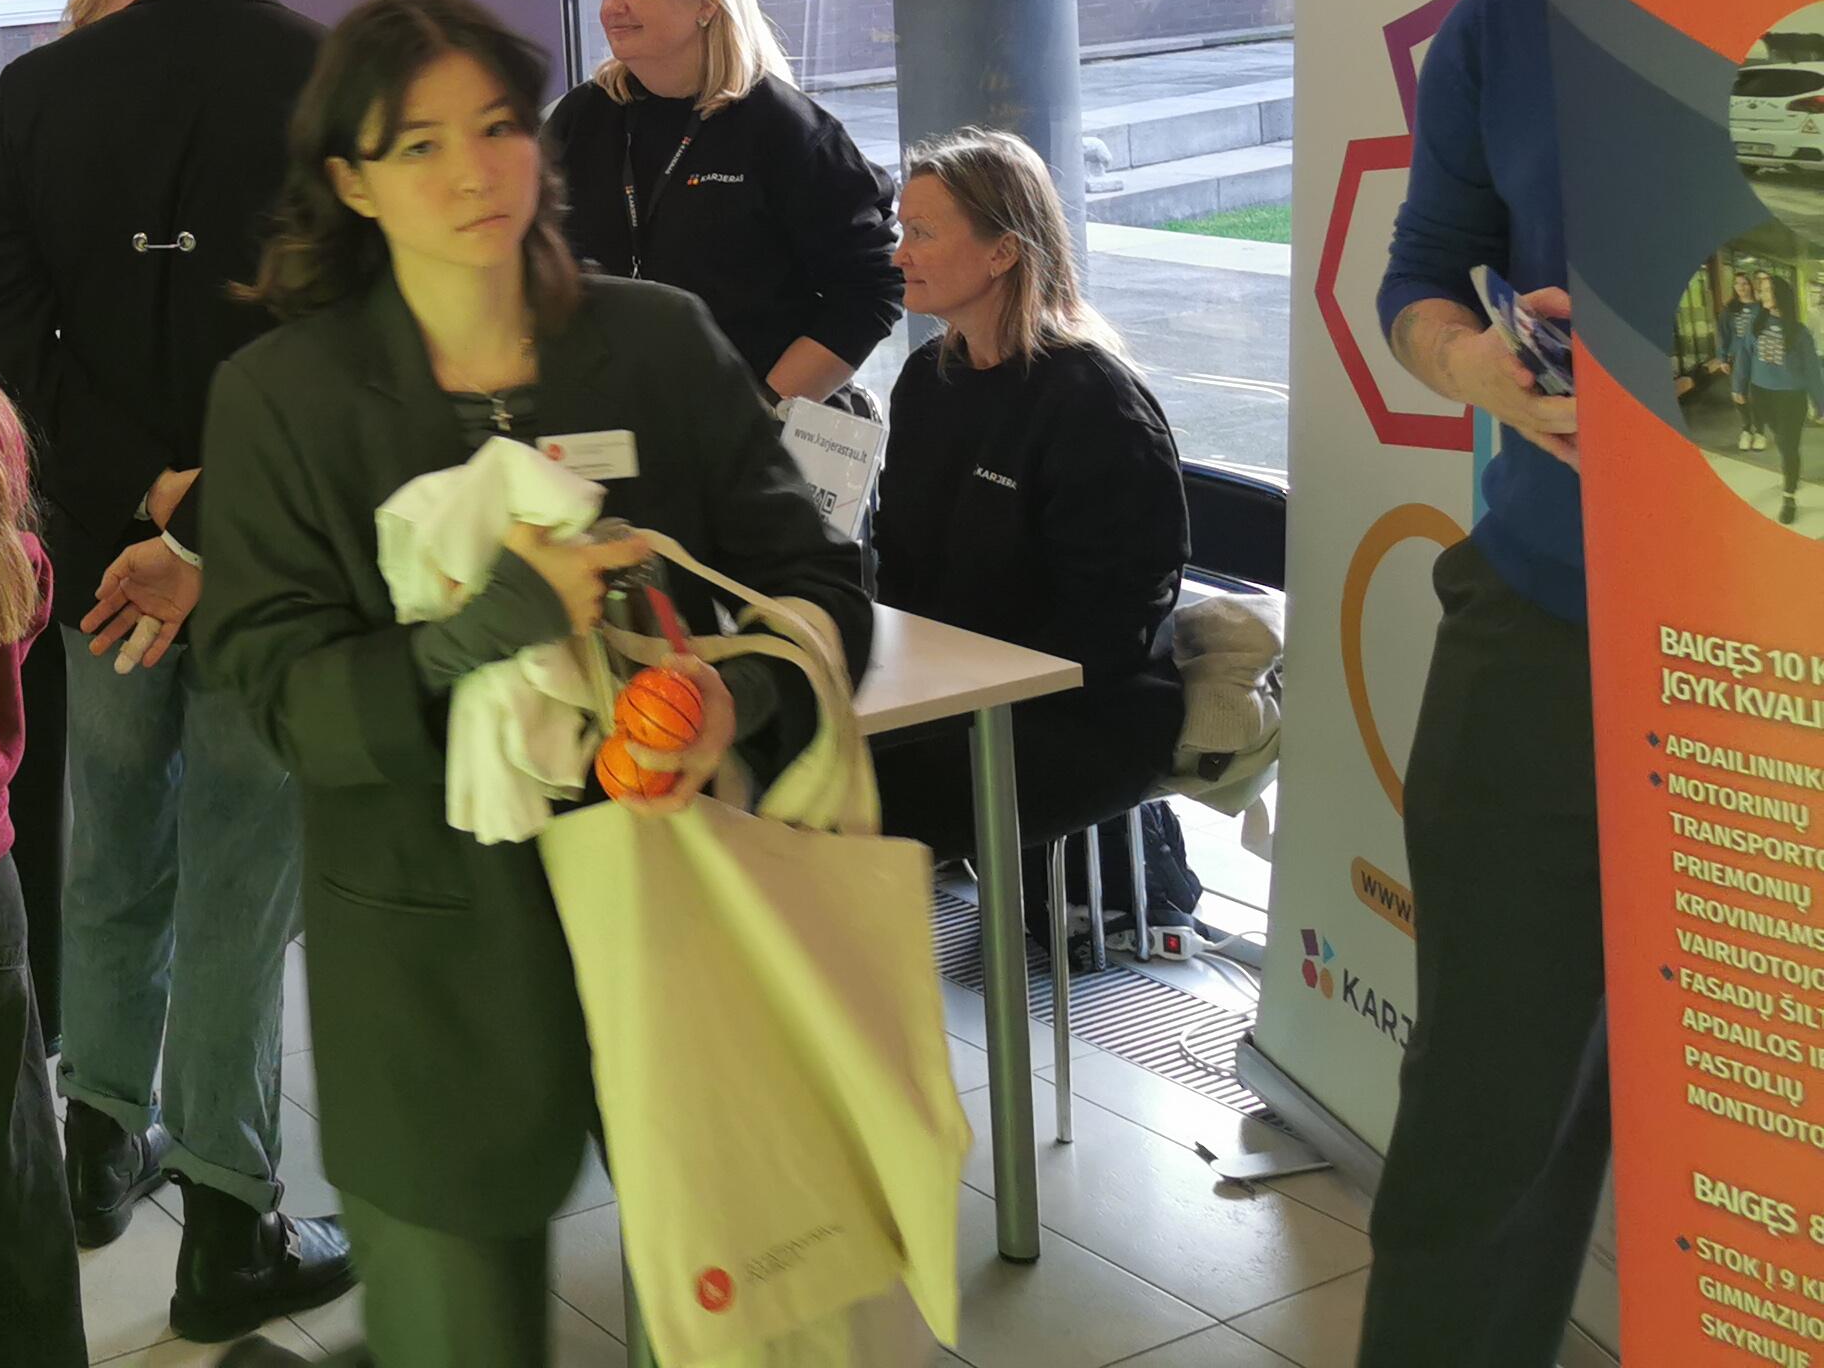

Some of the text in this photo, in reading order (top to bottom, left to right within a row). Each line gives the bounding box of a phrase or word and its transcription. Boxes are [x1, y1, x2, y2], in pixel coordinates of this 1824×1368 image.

[1660, 625, 1763, 679] BAIGĘS
[1766, 650, 1805, 682] 10
[1661, 667, 1731, 711] ĮGYK
[1665, 734, 1824, 791] APDAILININK
[1668, 772, 1810, 834] MOTORINIŲ
[1672, 850, 1812, 914] PRIEMONIŲ
[1675, 889, 1824, 952] KROVINIAMS
[1676, 927, 1824, 992] VAIRUOTOJO
[1680, 967, 1774, 1022] FASADŲ
[1682, 1007, 1804, 1063] APDAILOS
[1684, 1044, 1804, 1108] PASTOLIŲ
[1687, 1083, 1824, 1149] MONTUOTO
[1692, 1171, 1800, 1240] BAIGĘS
[1695, 1235, 1762, 1280] STOK
[1779, 1268, 1798, 1292] 9
[1698, 1274, 1824, 1343] GIMNAZIJO
